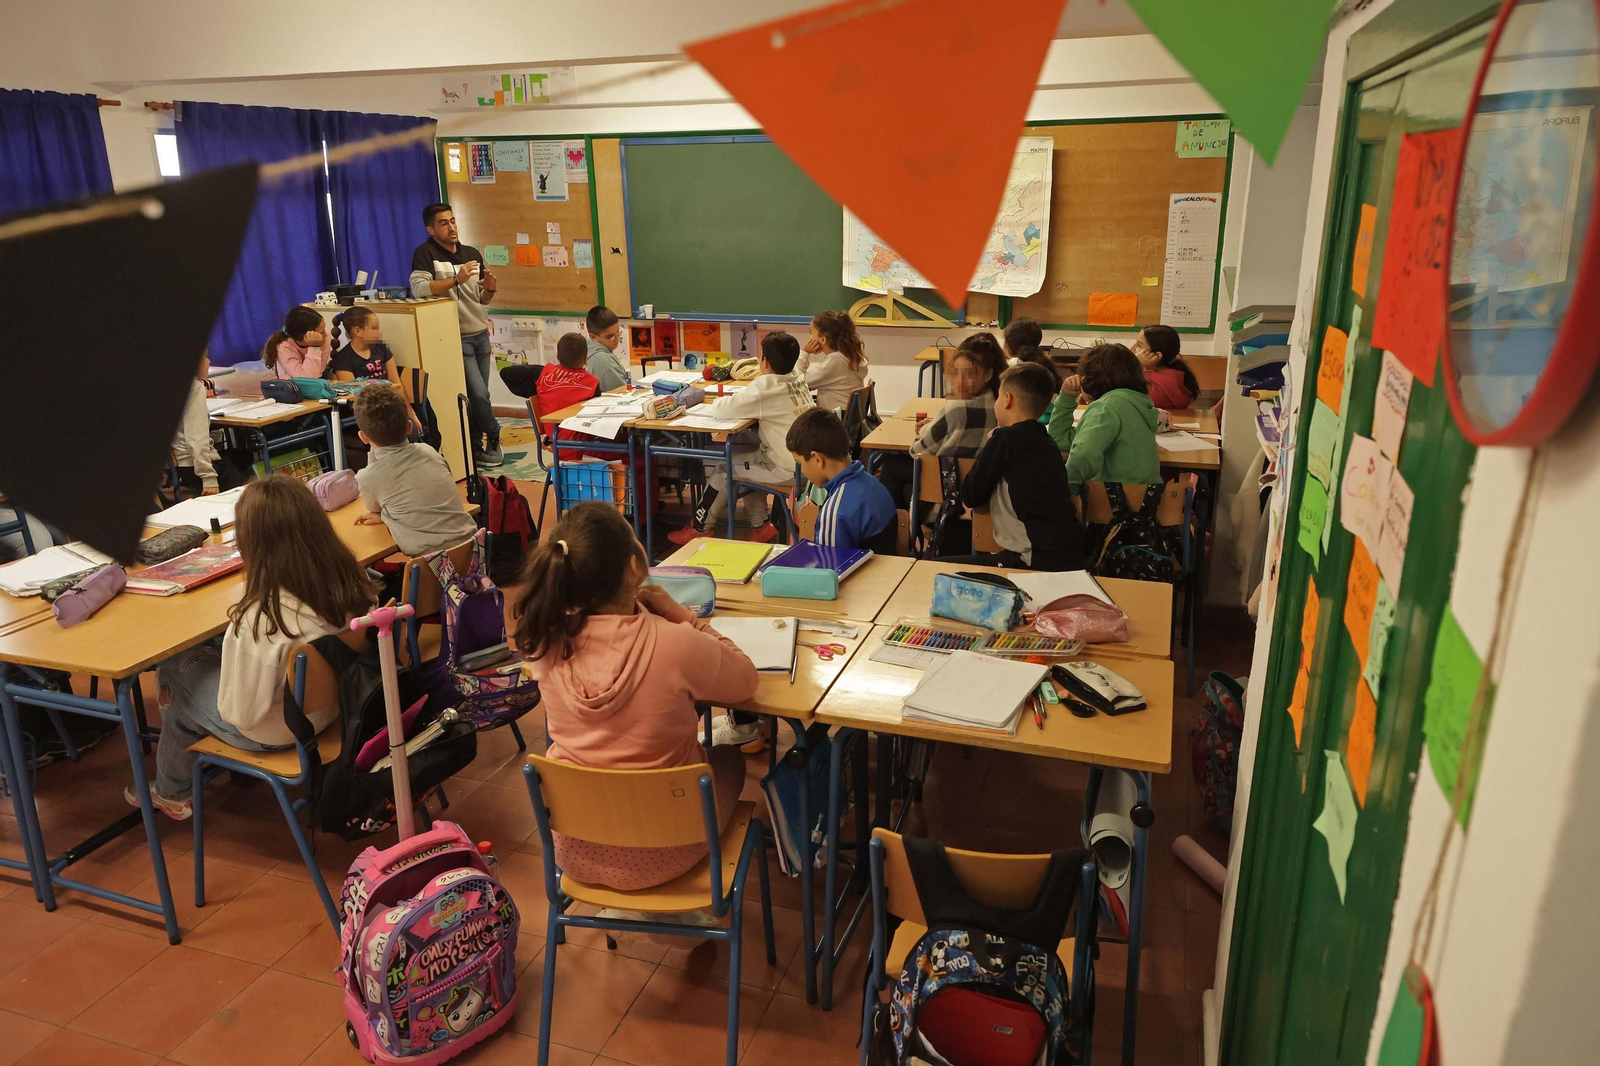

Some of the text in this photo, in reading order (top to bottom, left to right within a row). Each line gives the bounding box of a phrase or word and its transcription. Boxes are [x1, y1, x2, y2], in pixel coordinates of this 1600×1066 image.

[1192, 128, 1204, 137] DE
[366, 359, 382, 371] BE
[420, 939, 453, 969] ONLY
[946, 954, 971, 972] GOAL
